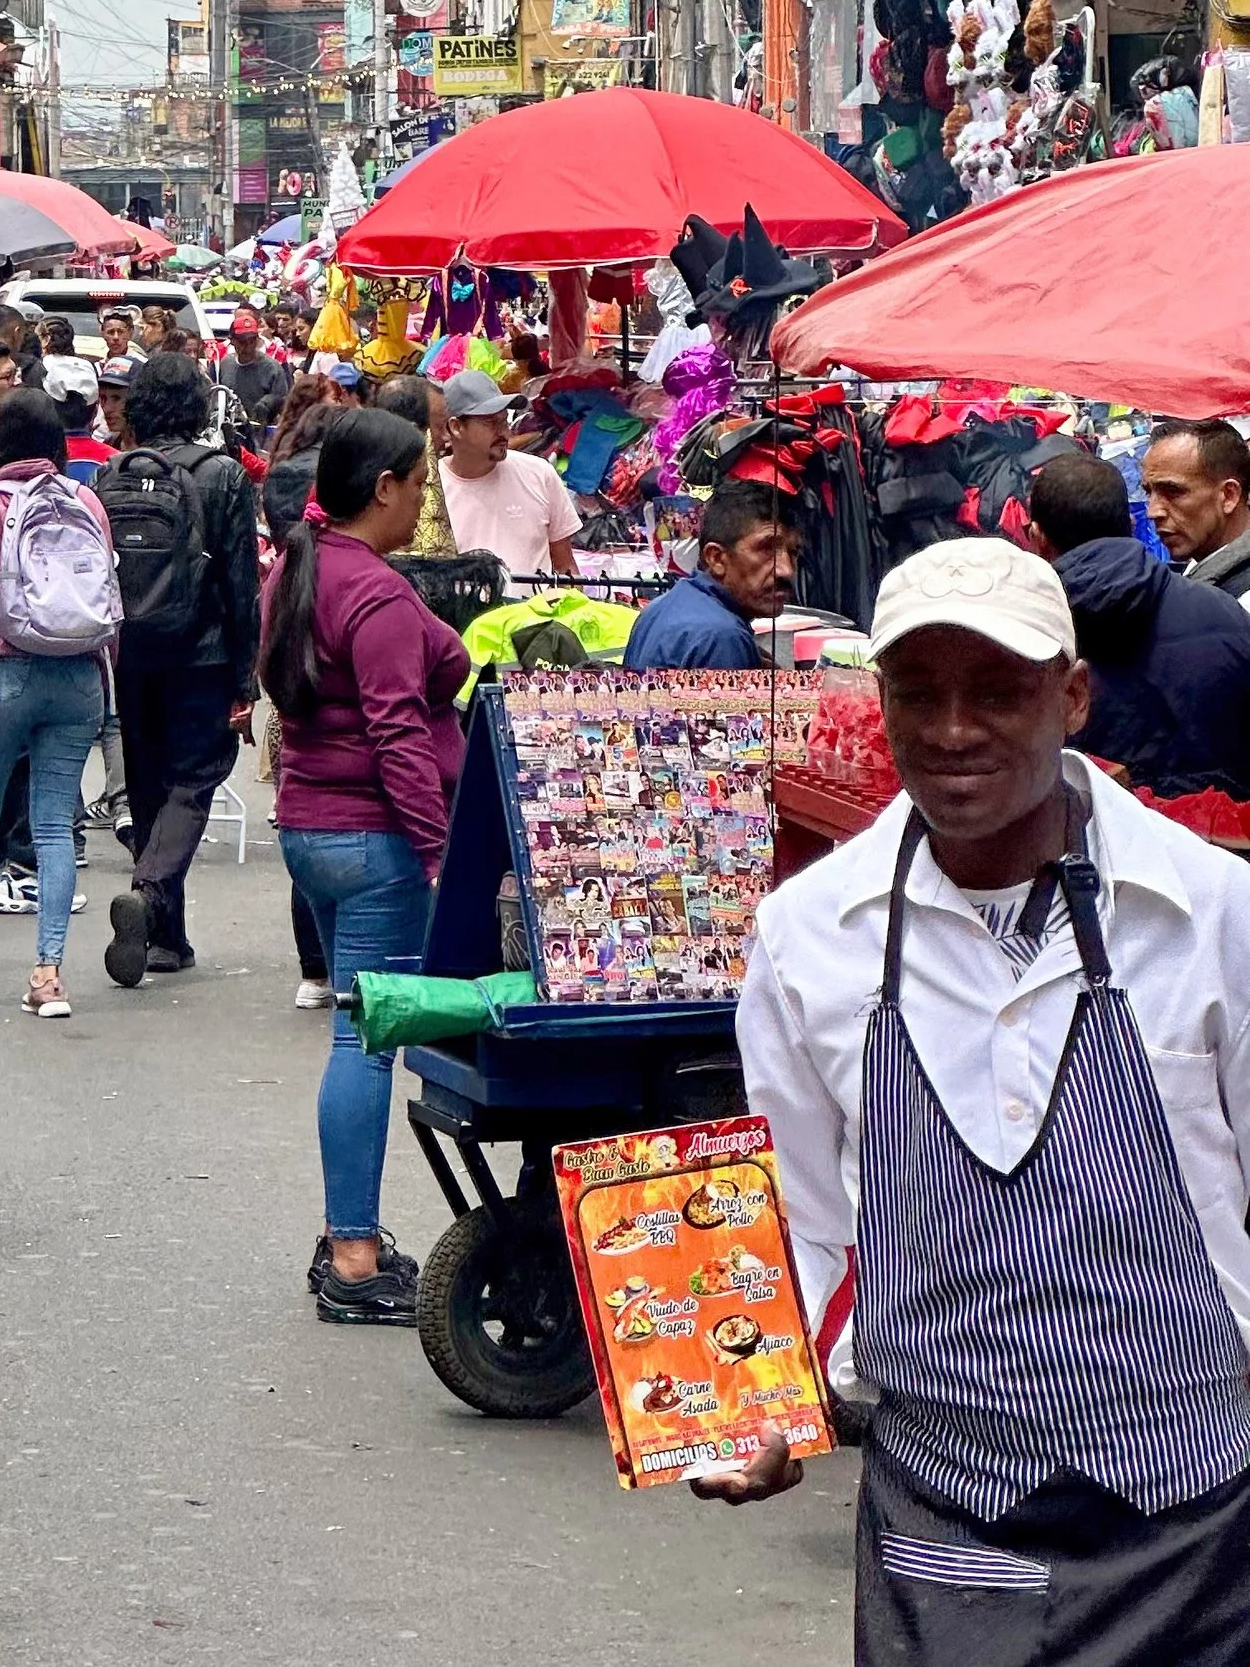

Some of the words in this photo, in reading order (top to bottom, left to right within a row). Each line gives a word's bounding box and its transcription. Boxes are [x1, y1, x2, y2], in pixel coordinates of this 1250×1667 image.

[391, 118, 418, 138] SALON
[686, 1130, 766, 1162] Almuerzos
[710, 1193, 742, 1215] Arroz
[746, 1192, 767, 1207] con
[636, 1209, 682, 1230] Costillas
[726, 1210, 755, 1229] Pollo
[731, 1269, 764, 1290] Bagre
[766, 1267, 782, 1280] en
[744, 1287, 775, 1303] Salsa
[646, 1302, 680, 1318] Viudo
[683, 1298, 698, 1313] de
[658, 1319, 696, 1337] Capaz
[757, 1336, 794, 1356] Ajiaco
[678, 1382, 713, 1398] Carne
[753, 1389, 781, 1404] Mucho
[682, 1399, 719, 1417] Asada
